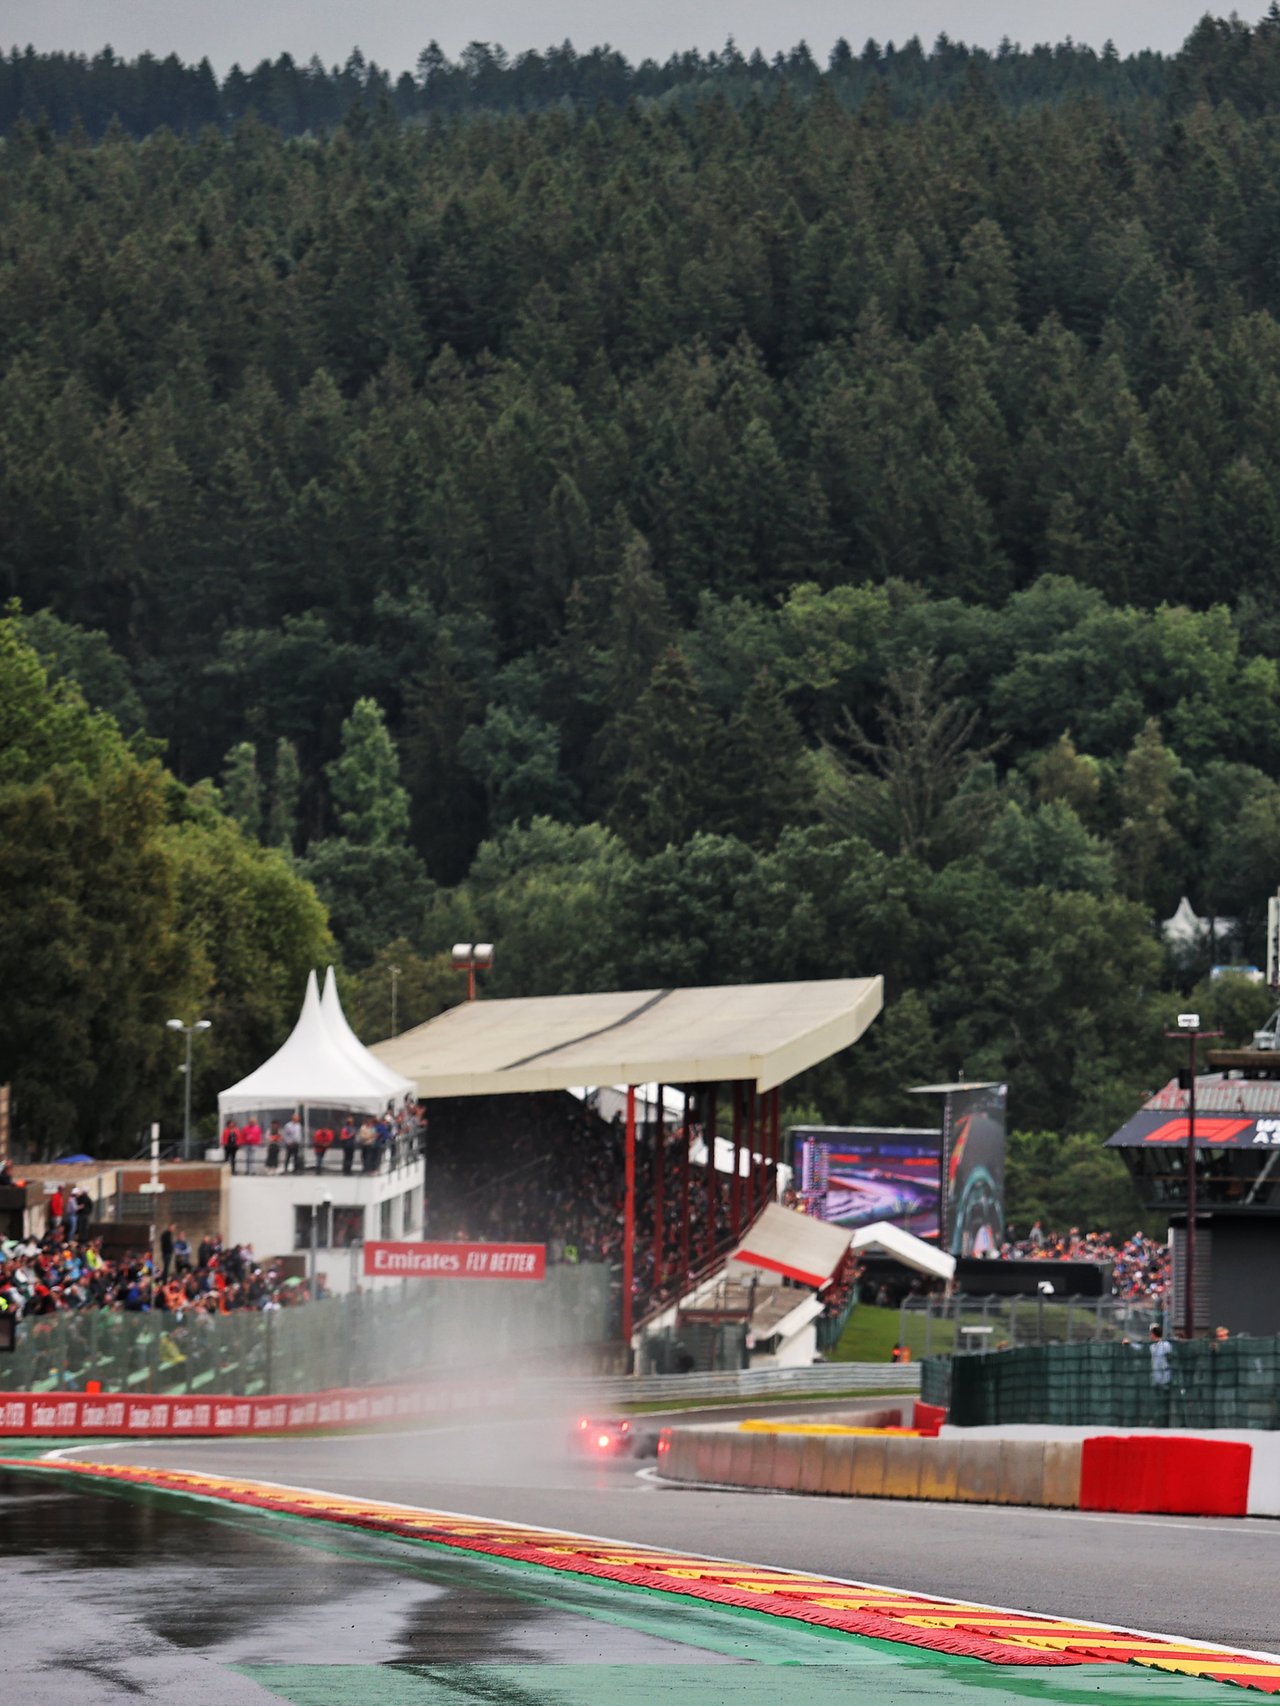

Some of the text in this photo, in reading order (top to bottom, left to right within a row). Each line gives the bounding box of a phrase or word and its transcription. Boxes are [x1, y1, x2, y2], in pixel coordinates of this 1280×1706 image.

[374, 1249, 537, 1273] Emirates FLY BETTER
